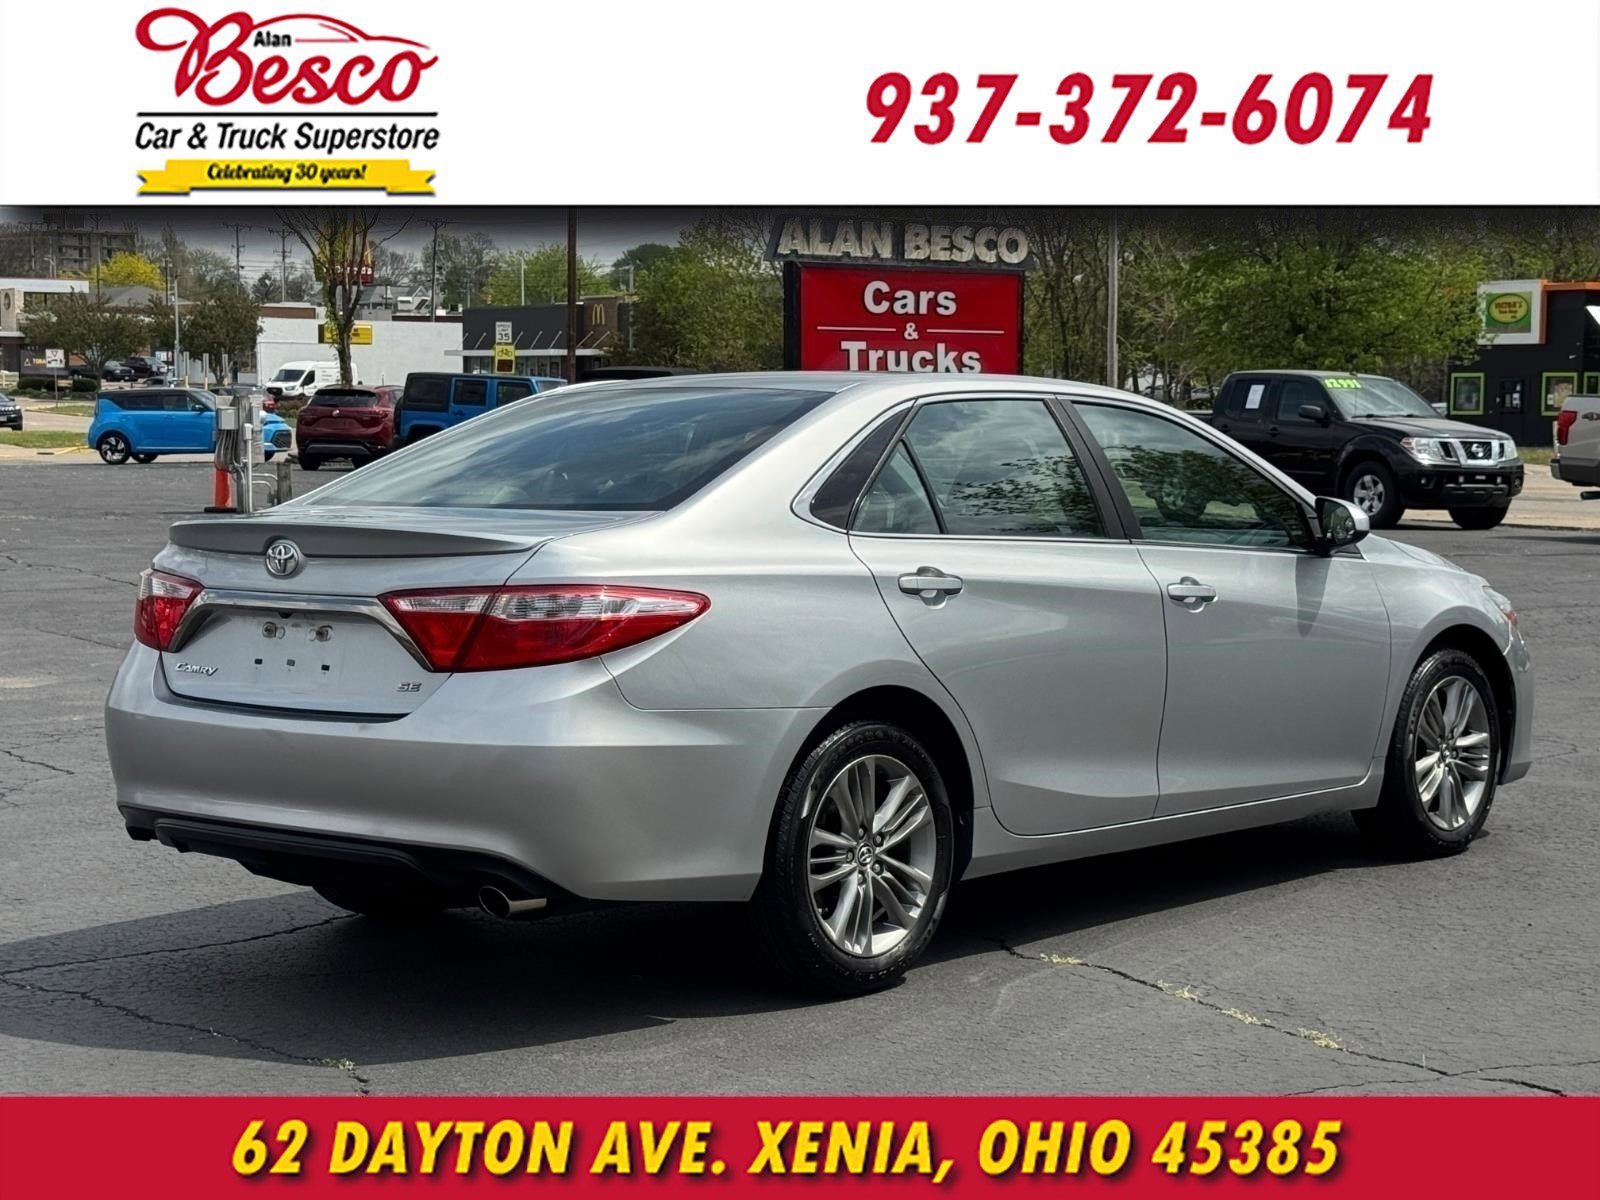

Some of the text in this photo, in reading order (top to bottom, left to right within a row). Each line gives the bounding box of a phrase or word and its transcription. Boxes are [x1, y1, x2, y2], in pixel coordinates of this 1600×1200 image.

[777, 216, 1029, 265] ALAN BESCO
[863, 280, 957, 316] Cars
[497, 332, 510, 341] 35
[903, 322, 919, 340] &
[840, 340, 983, 374] Trucks
[397, 681, 421, 693] SE
